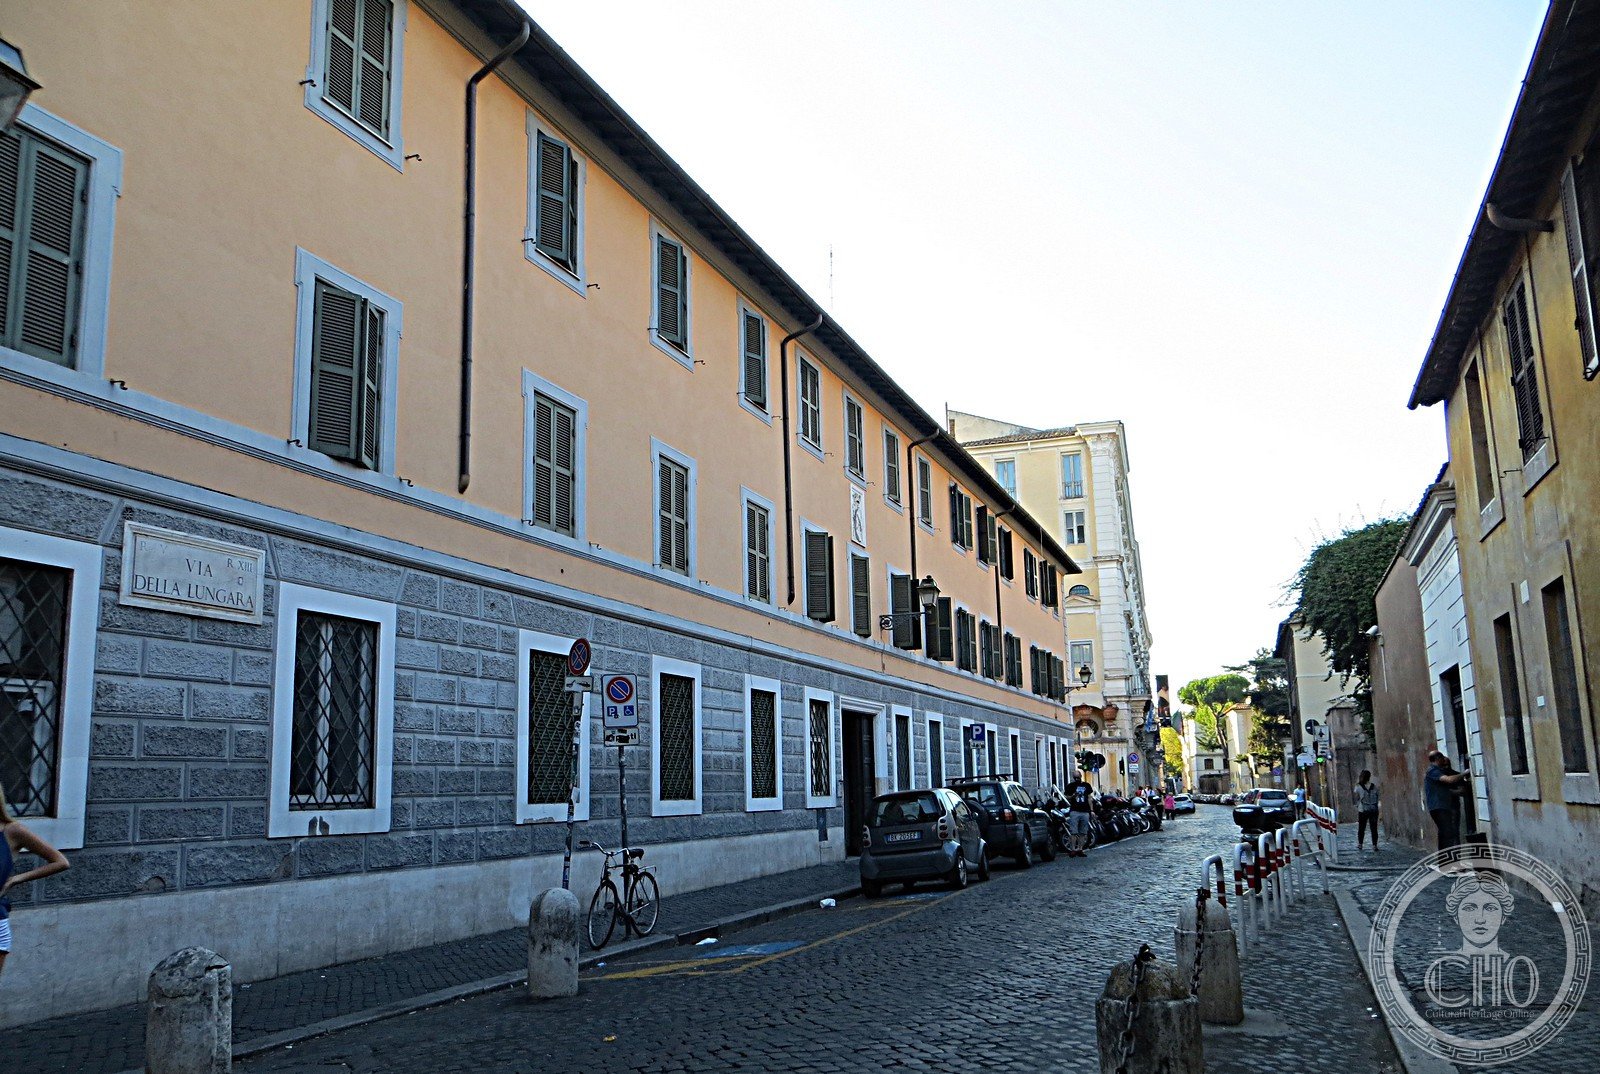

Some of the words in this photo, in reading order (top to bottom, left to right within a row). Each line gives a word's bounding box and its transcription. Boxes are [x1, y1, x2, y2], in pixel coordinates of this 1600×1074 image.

[185, 558, 213, 578] VIA
[134, 574, 180, 597] DELLA
[187, 583, 254, 609] LUNGARA
[972, 725, 982, 739] P
